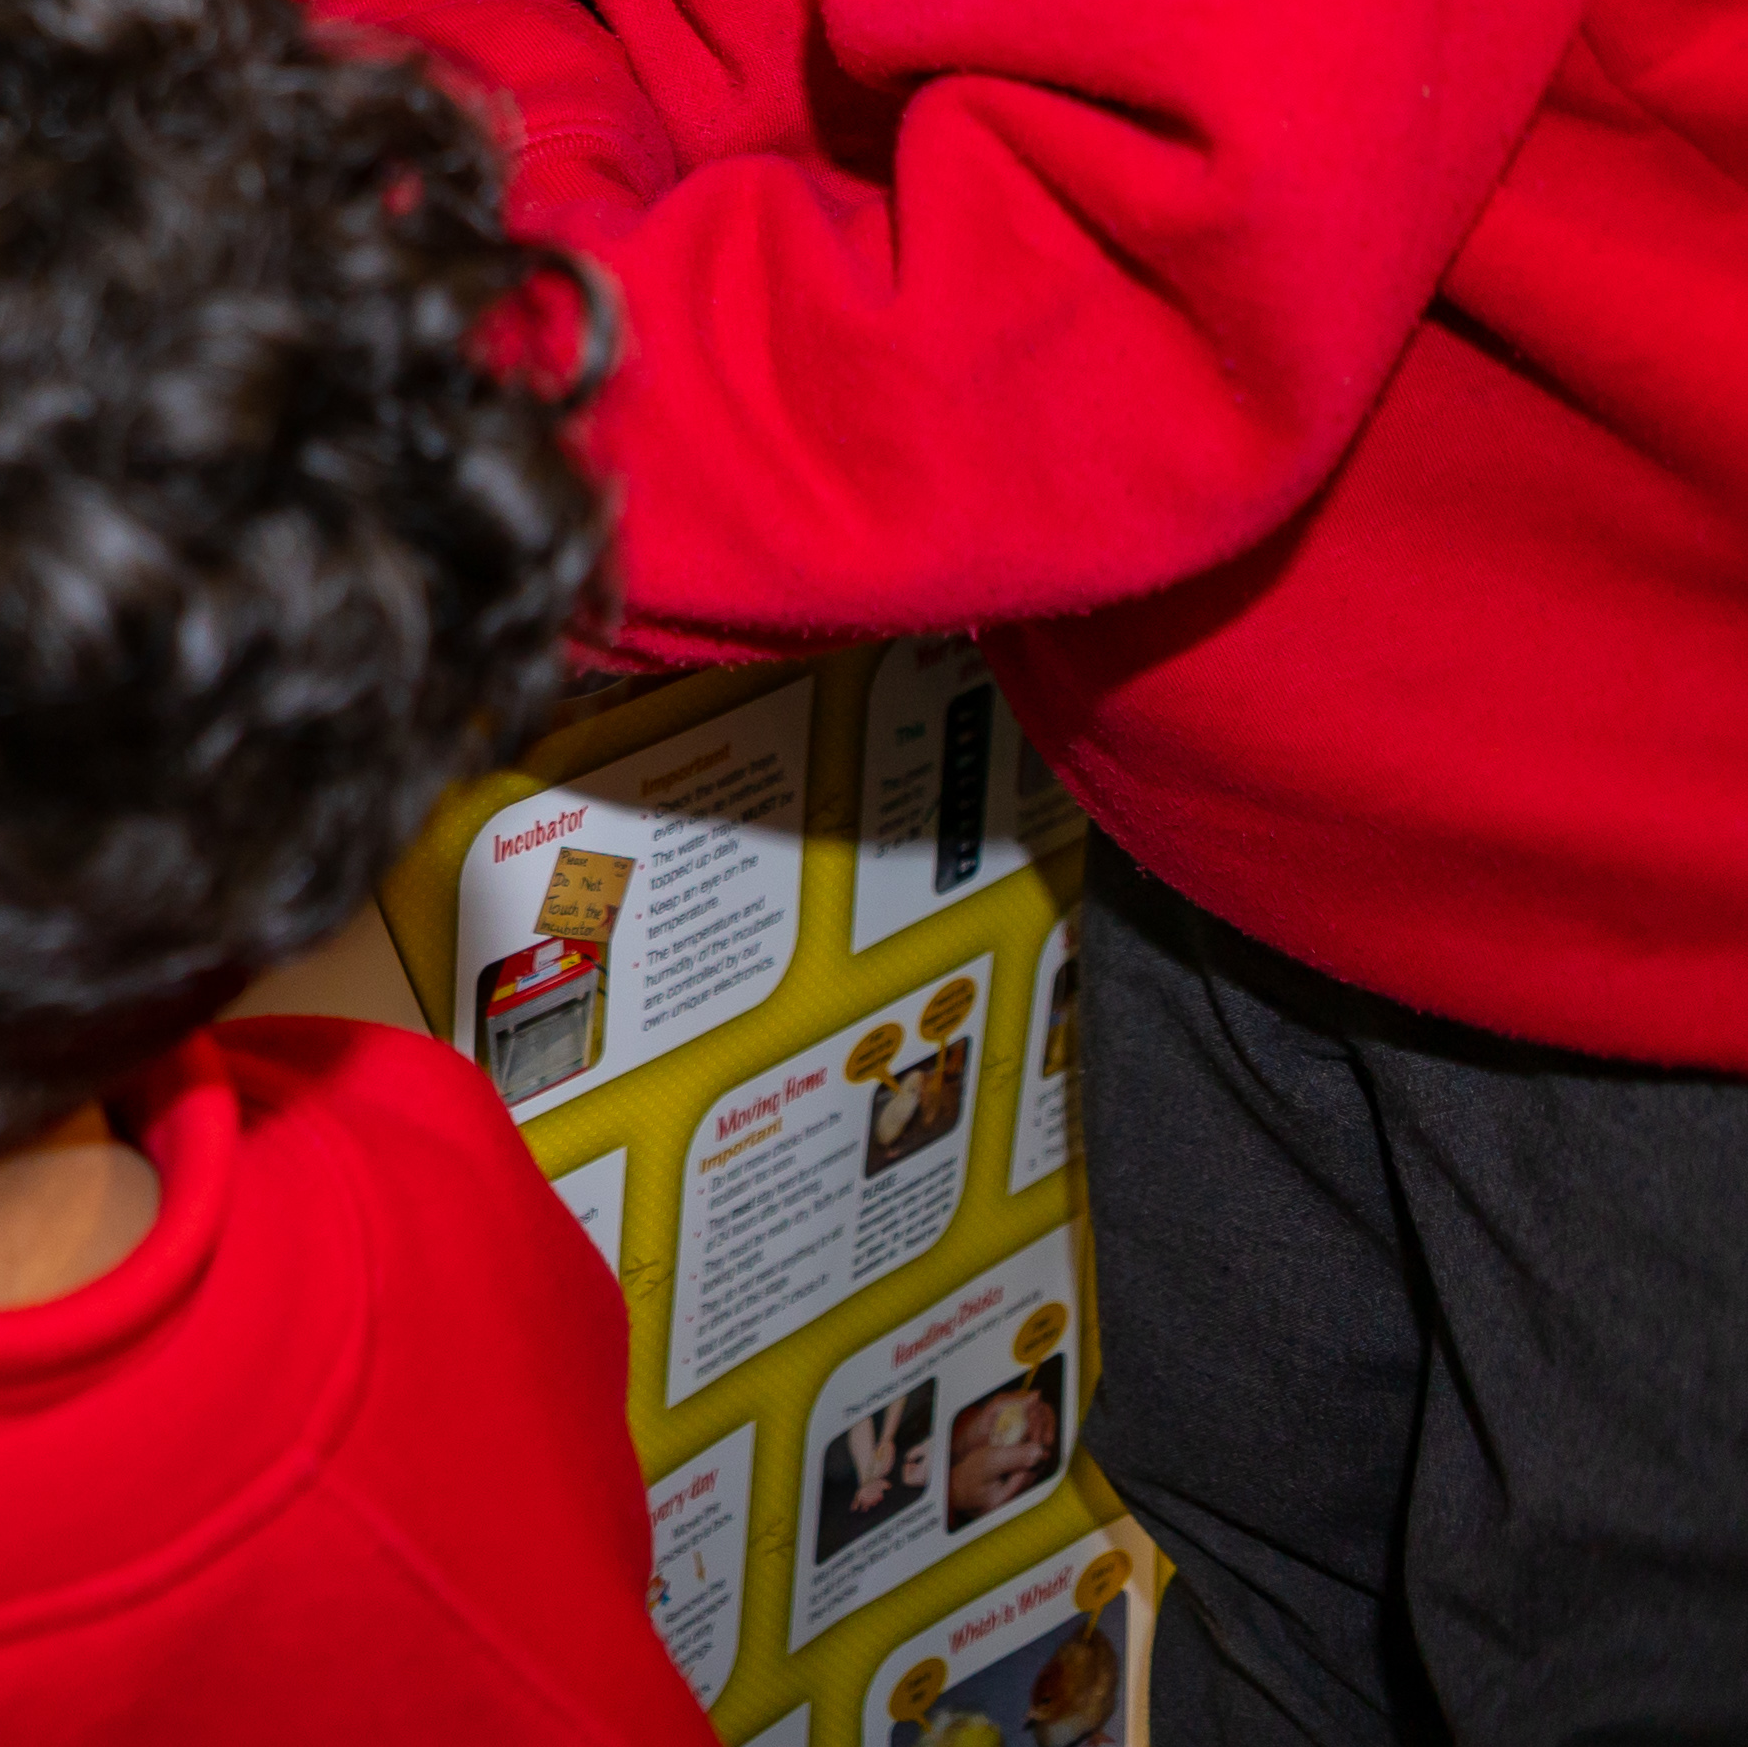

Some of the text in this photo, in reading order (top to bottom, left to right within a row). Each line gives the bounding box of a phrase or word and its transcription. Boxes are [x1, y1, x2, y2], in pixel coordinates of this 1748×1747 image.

[494, 805, 588, 863] Incubator
[652, 850, 673, 866] The
[678, 833, 707, 855] water
[712, 816, 737, 839] trays
[653, 817, 683, 841] every
[552, 871, 603, 892] Do Not
[650, 860, 692, 890] topped
[696, 853, 710, 869] up
[650, 855, 758, 915] Keep an eye on the
[548, 894, 601, 920] Touch the
[647, 896, 765, 964] The temperature and
[645, 956, 693, 988] humidity
[712, 938, 729, 955] the
[733, 910, 784, 943] incubator
[645, 942, 761, 1010] are controlled by our
[643, 1011, 667, 1031] own
[672, 989, 709, 1017] unique
[717, 1065, 826, 1141] Moving Home
[700, 1118, 782, 1173] Important
[653, 1492, 684, 1527] very
